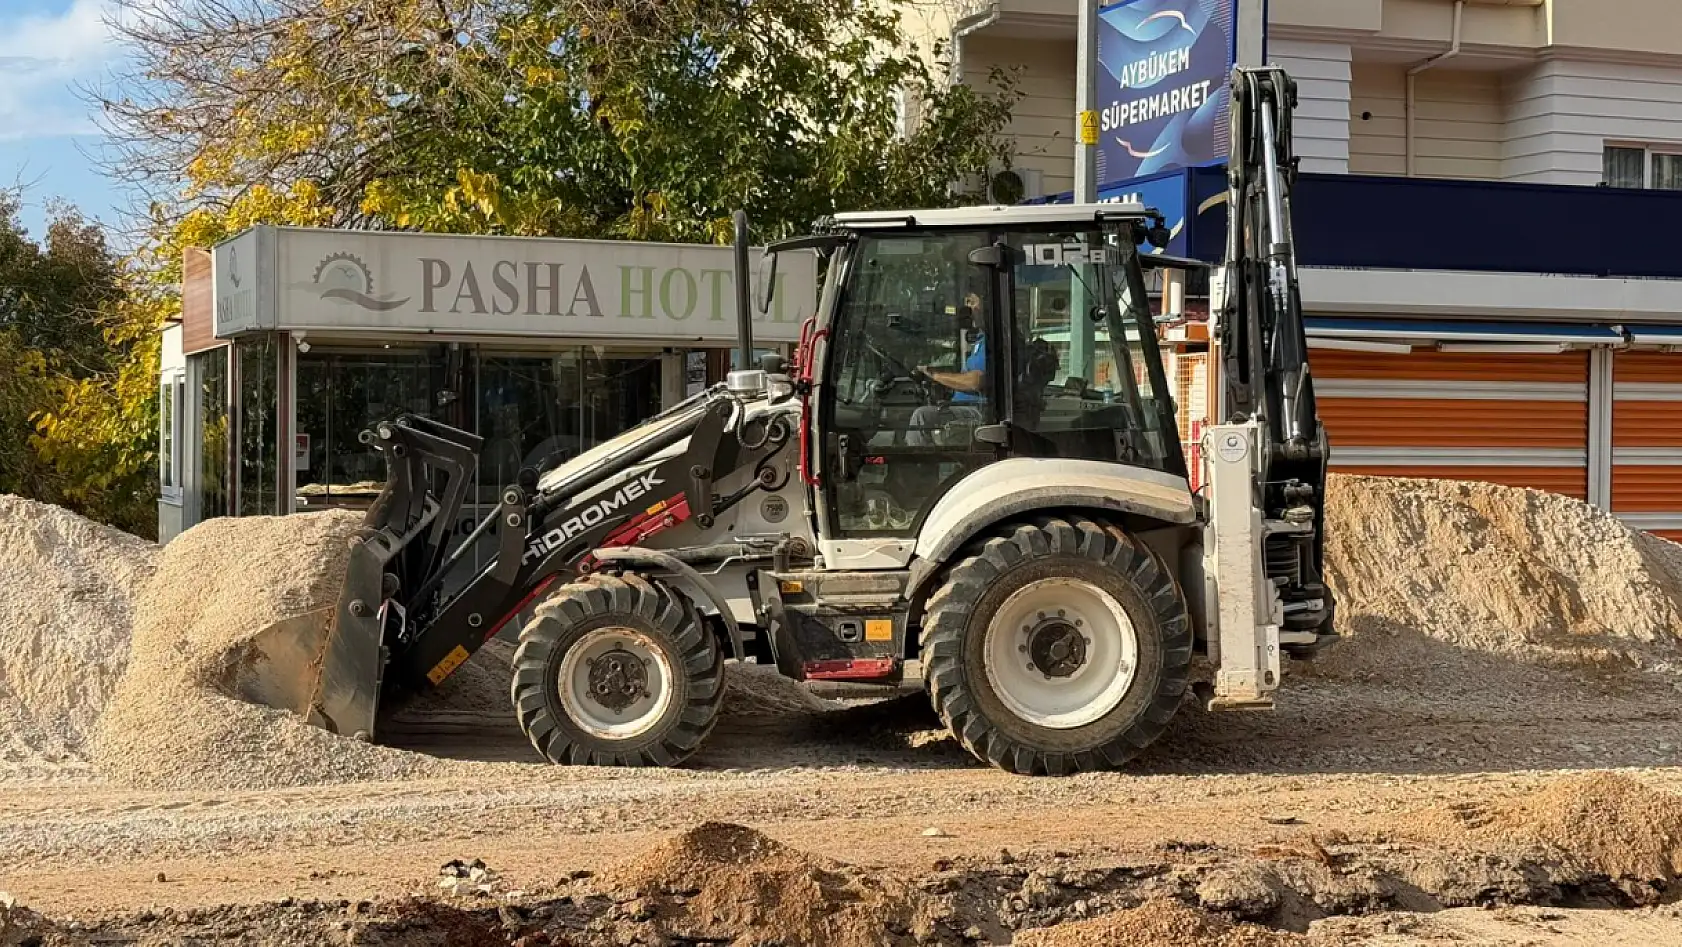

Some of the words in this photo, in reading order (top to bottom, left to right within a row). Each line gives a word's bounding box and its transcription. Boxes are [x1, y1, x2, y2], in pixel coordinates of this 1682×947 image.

[1119, 47, 1190, 88] AYBÜKEM
[1101, 80, 1210, 132] SÜPERMARKET
[418, 257, 603, 317] PASHA
